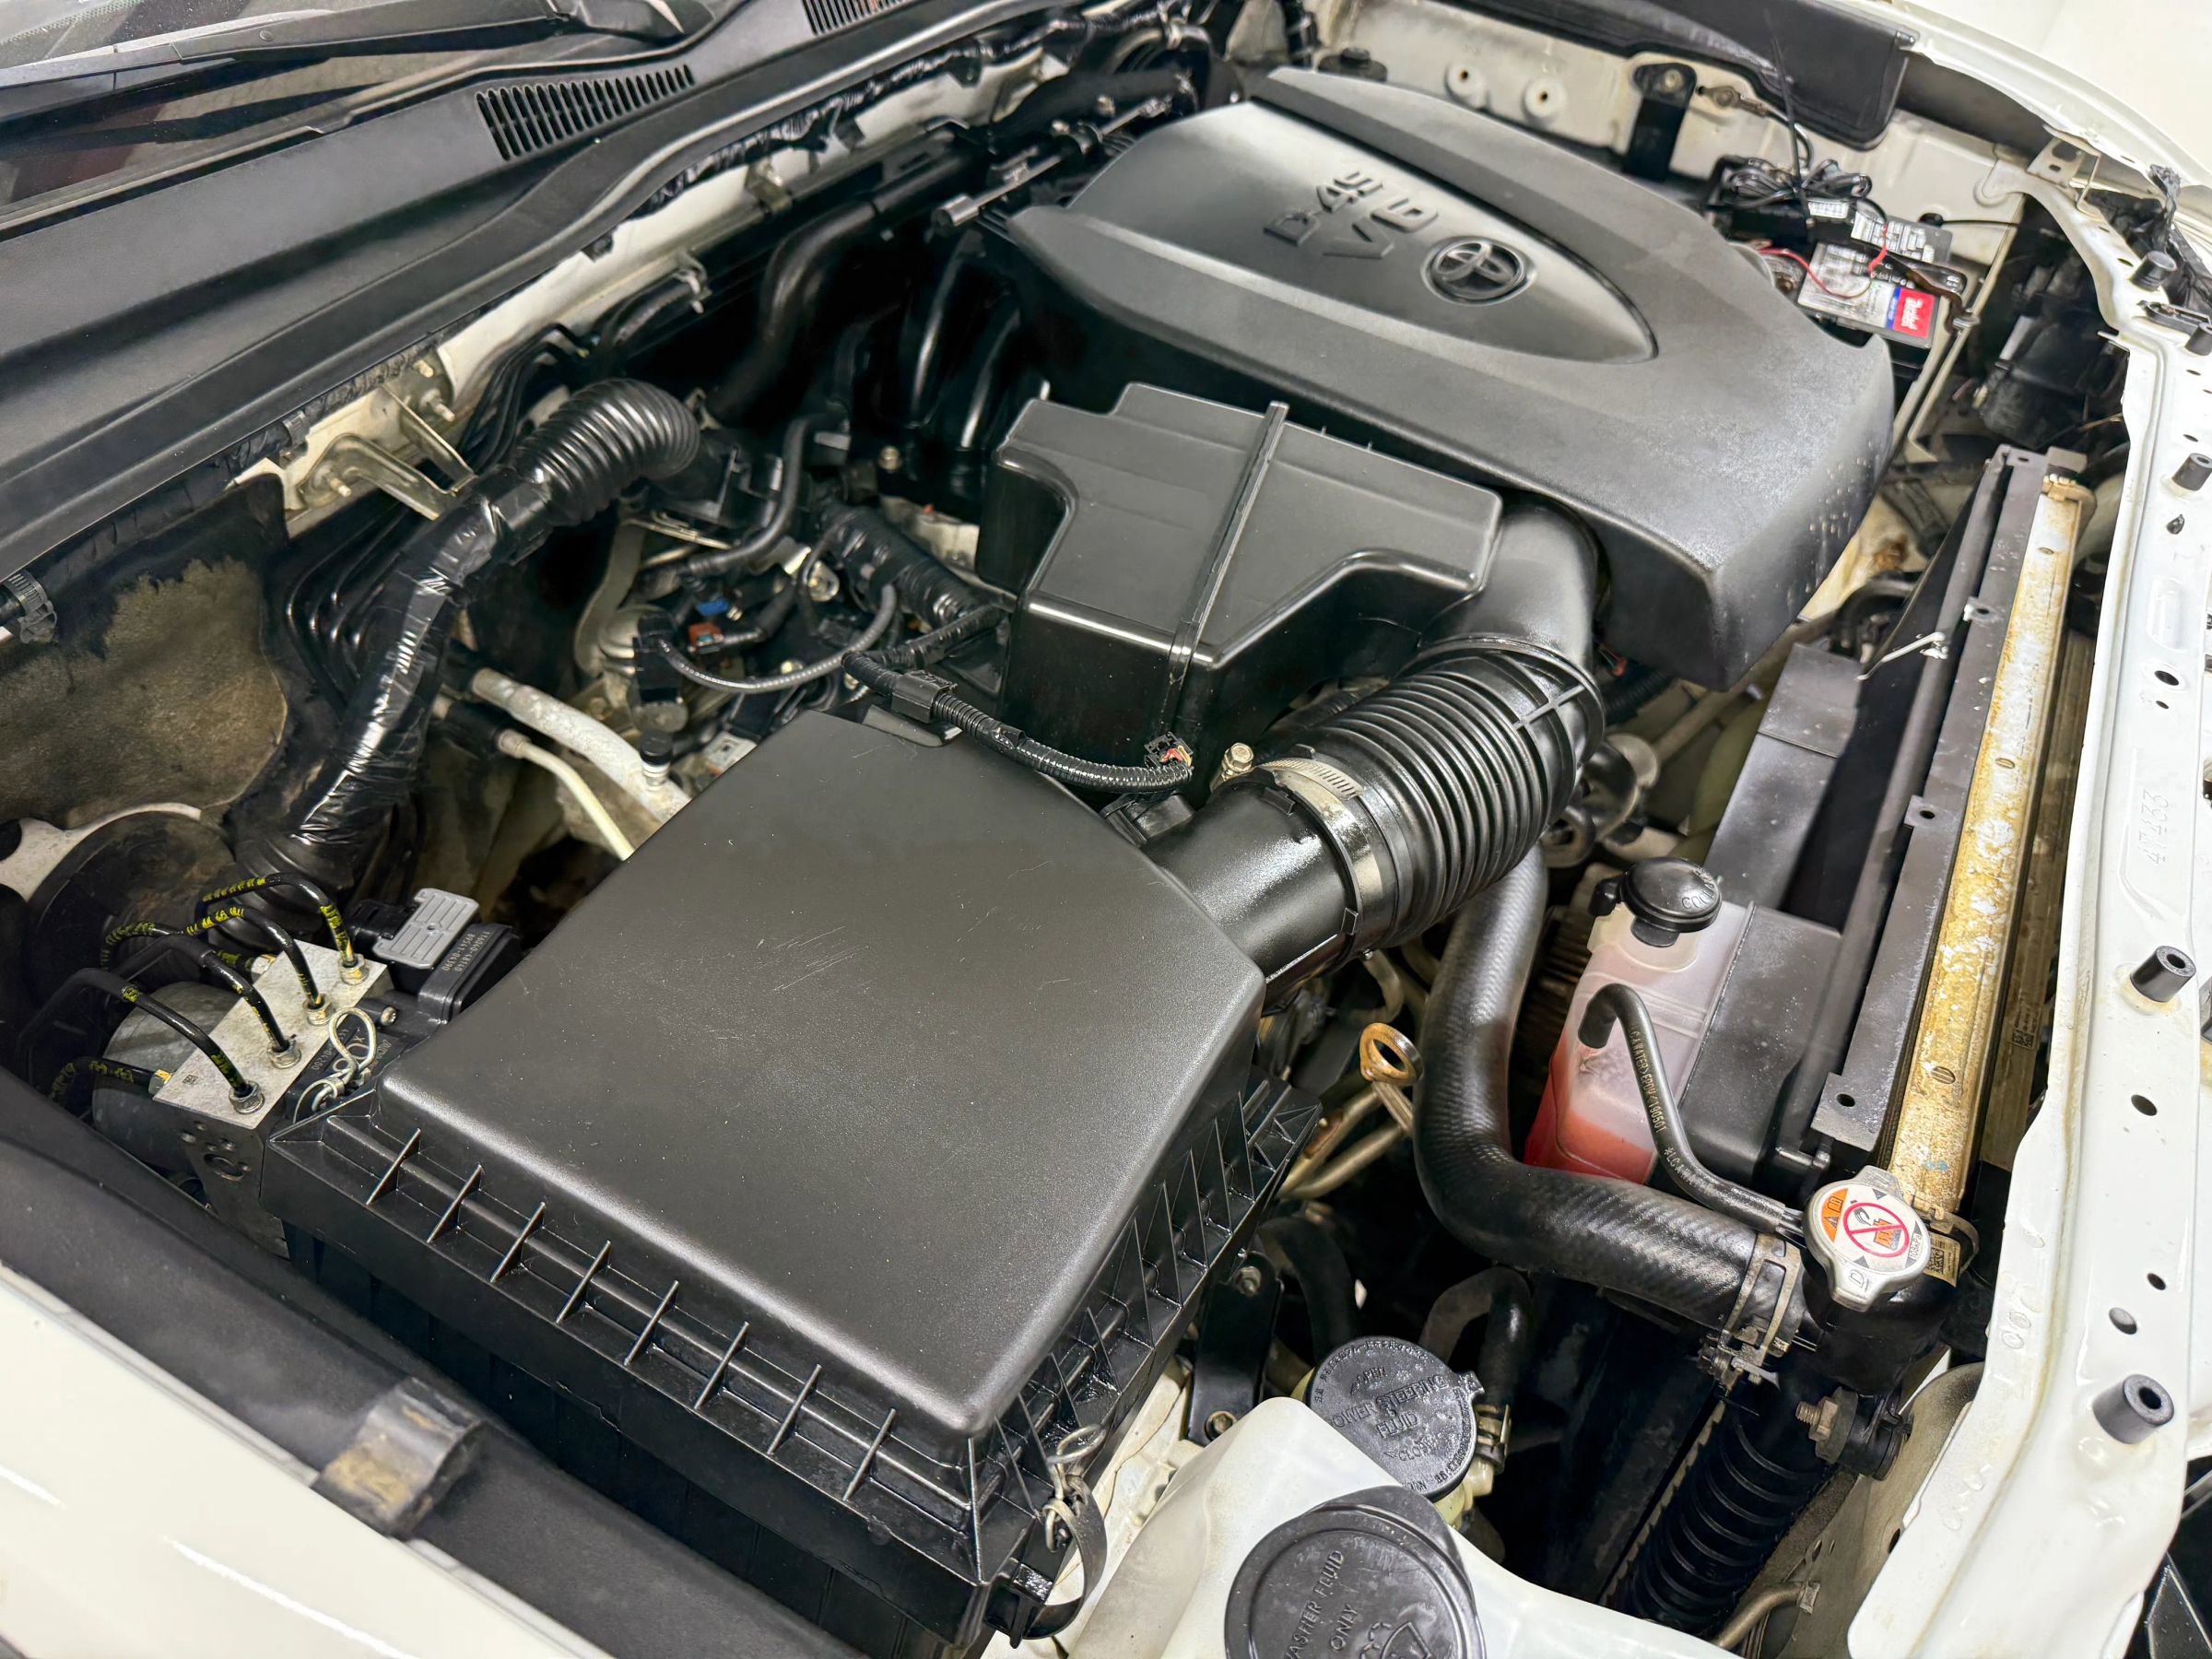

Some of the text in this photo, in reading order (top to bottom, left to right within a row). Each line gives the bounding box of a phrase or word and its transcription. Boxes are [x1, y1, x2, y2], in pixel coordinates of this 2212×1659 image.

[1323, 198, 1440, 260] V6
[1375, 1374, 1448, 1411] STEERING
[1377, 1410, 1418, 1441] FLUID
[1312, 1549, 1346, 1597] FLUID
[1329, 1605, 1360, 1653] ONLY
